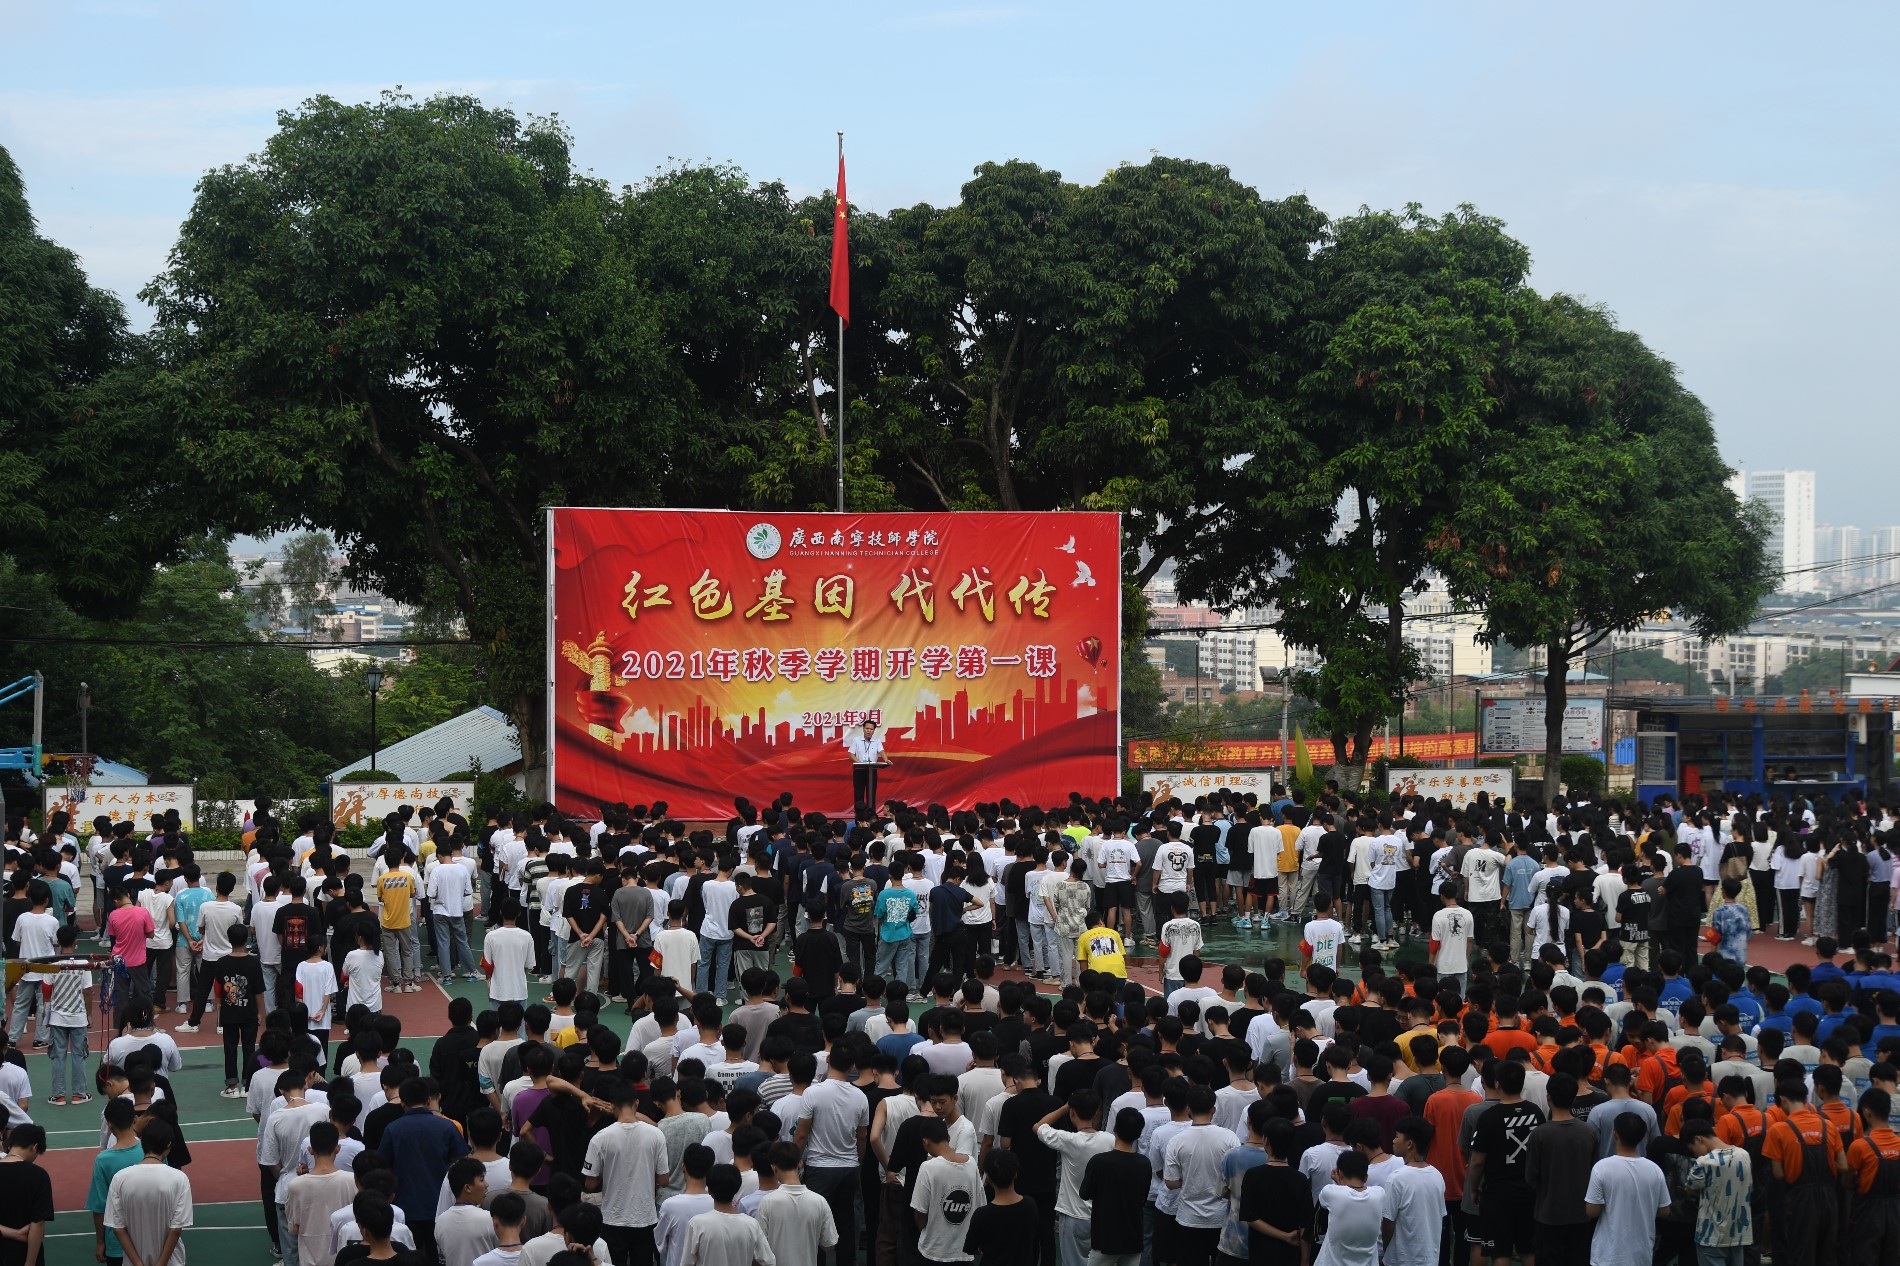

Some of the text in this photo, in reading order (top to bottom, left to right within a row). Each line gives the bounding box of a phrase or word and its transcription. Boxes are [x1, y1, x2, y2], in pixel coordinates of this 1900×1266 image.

[789, 527, 939, 548] 廣西南寧技師學院
[622, 566, 1057, 623] 红色基因 代代传
[622, 644, 1057, 682] 2021年秋季学期开学第一课
[802, 708, 883, 728] 2021年9月
[1182, 775, 1242, 787] 诚信明理
[1428, 775, 1484, 788] 乐学善思
[92, 791, 160, 805] 育人为本
[376, 787, 440, 800] 厚德尚技
[1317, 940, 1334, 952] DIE
